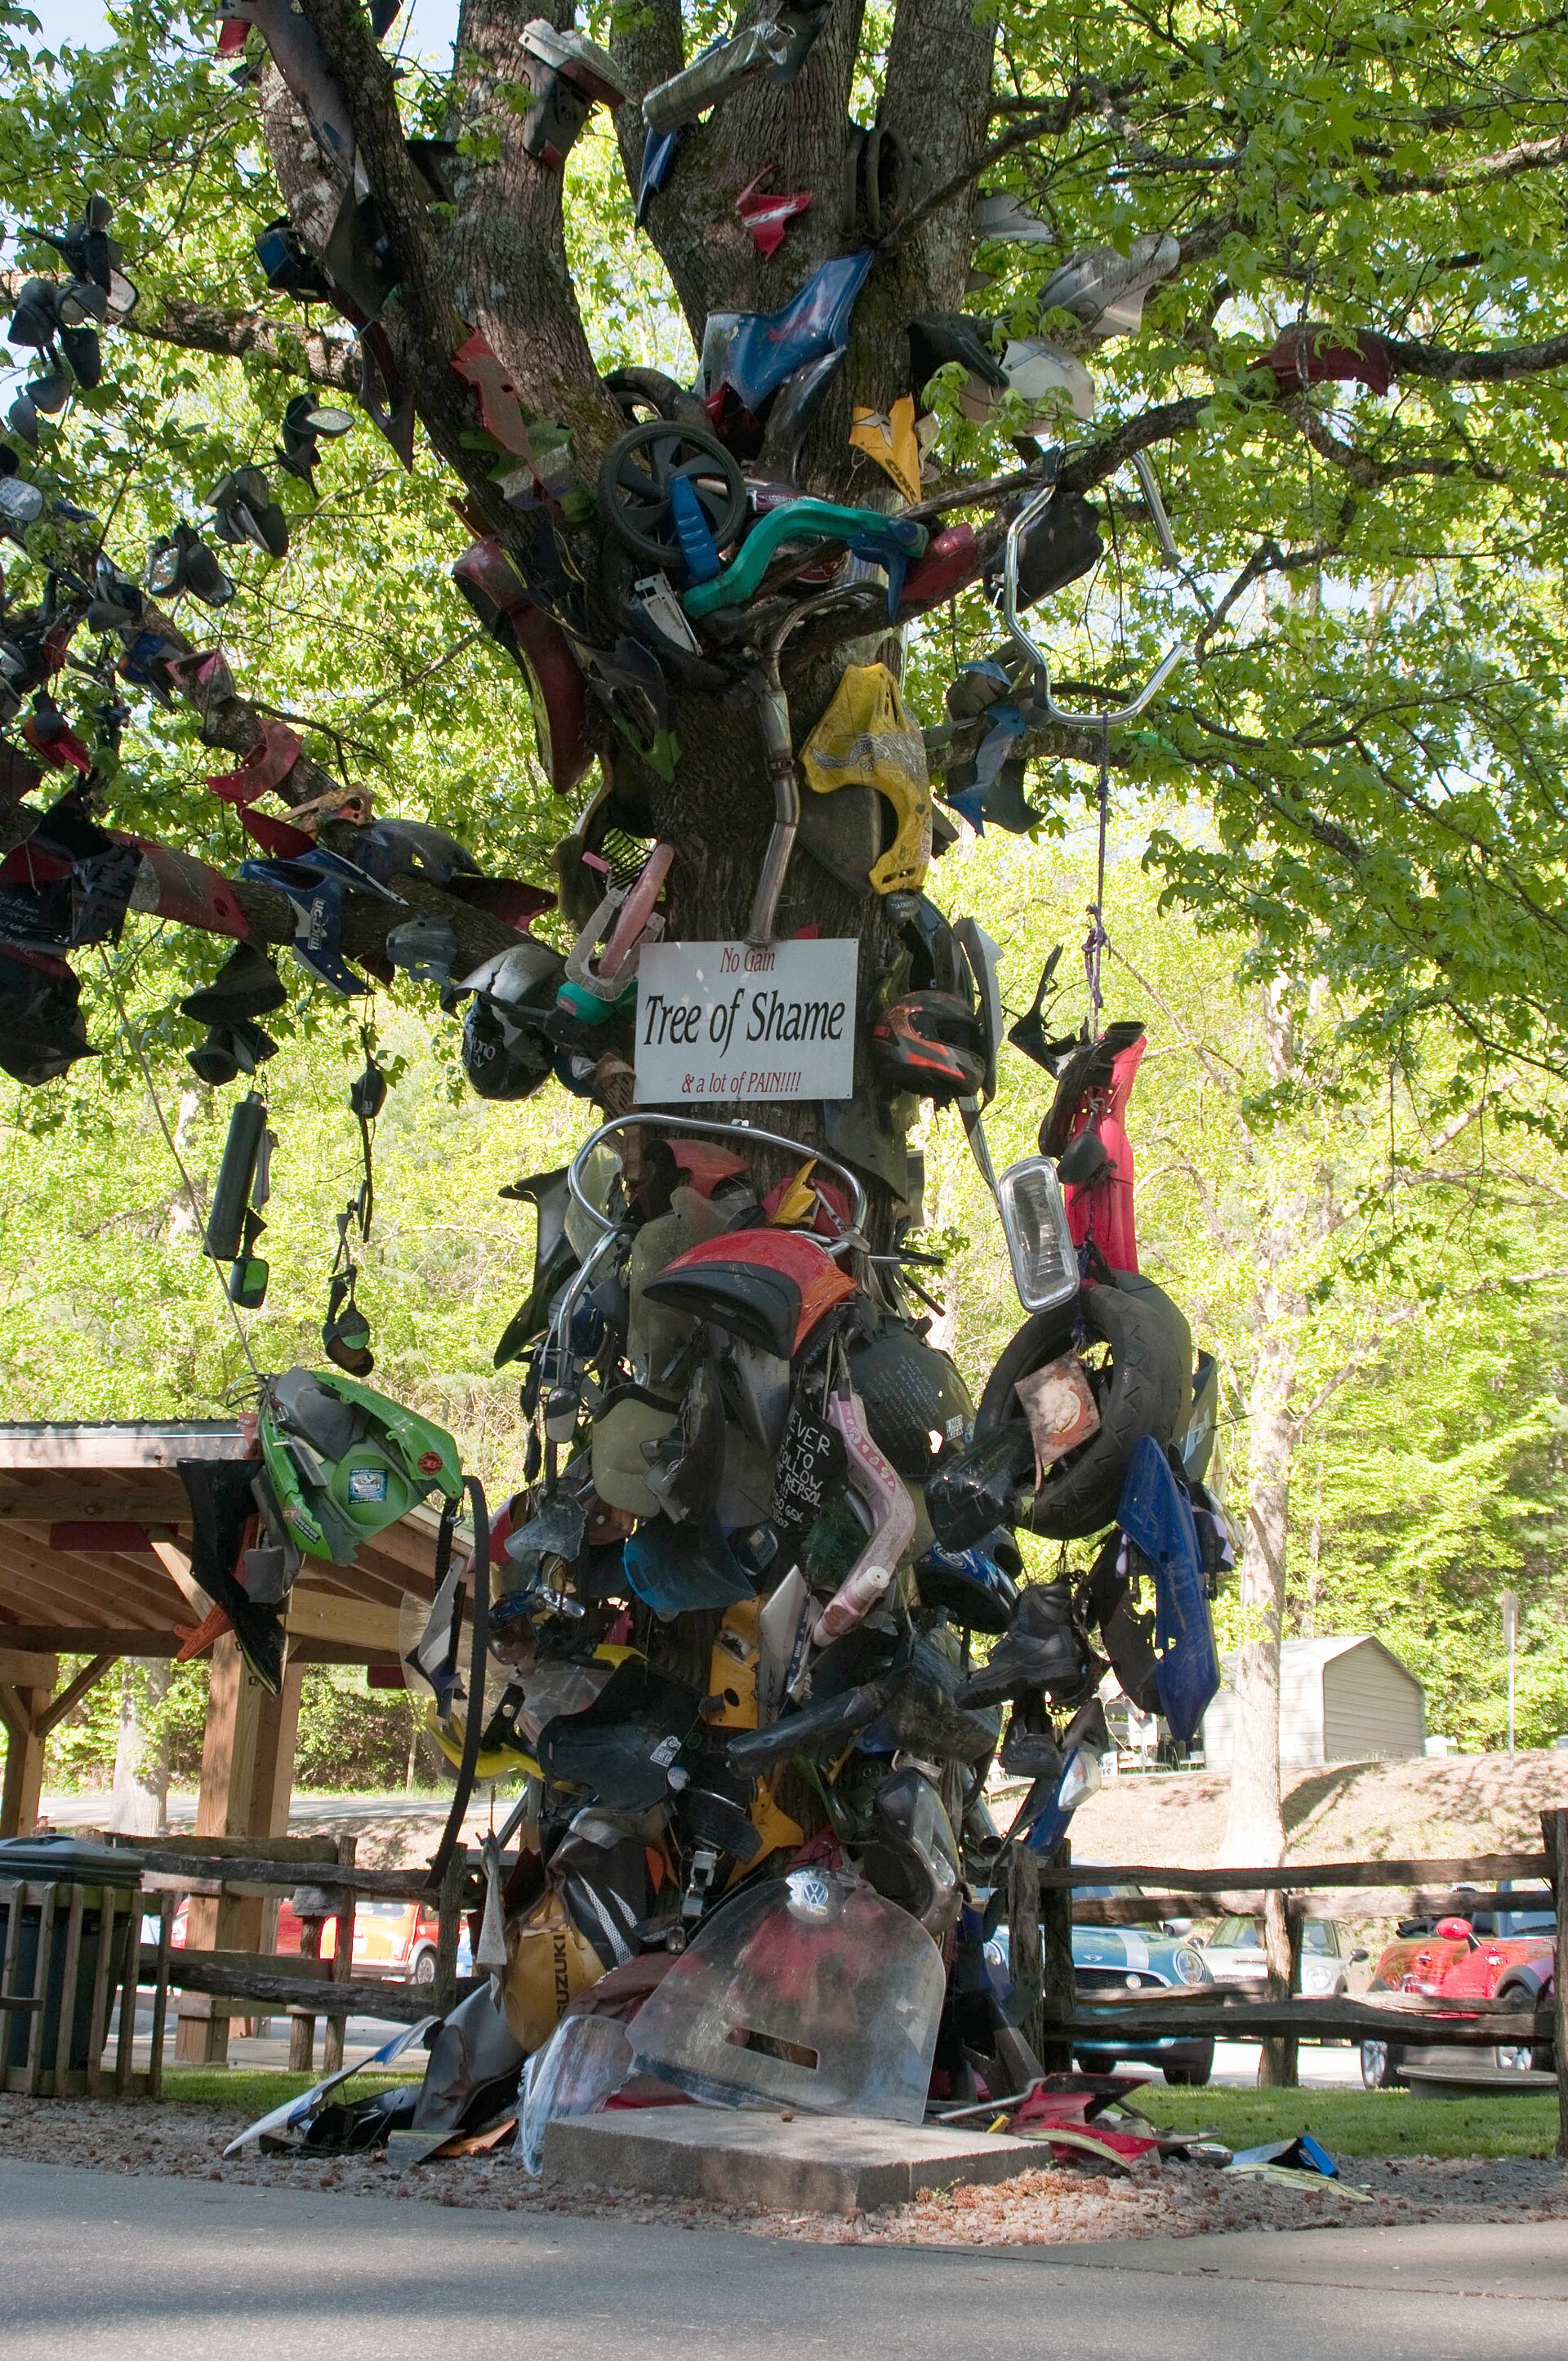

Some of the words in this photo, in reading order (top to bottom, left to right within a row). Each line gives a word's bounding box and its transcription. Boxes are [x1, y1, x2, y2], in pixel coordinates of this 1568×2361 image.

[719, 947, 740, 973] No
[743, 947, 775, 972] Gain
[644, 993, 702, 1045] Tree
[709, 988, 745, 1058] of
[746, 990, 845, 1042] Shame
[681, 1073, 694, 1094] &
[696, 1078, 705, 1093] a
[709, 1072, 727, 1093] lot
[730, 1071, 746, 1098] of
[746, 1071, 802, 1093] PAIN!!!!
[795, 1444, 814, 1470] TO
[784, 1472, 821, 1508] REPSOL
[785, 1505, 804, 1523] GSX
[553, 1934, 570, 2020] SUZUKI
